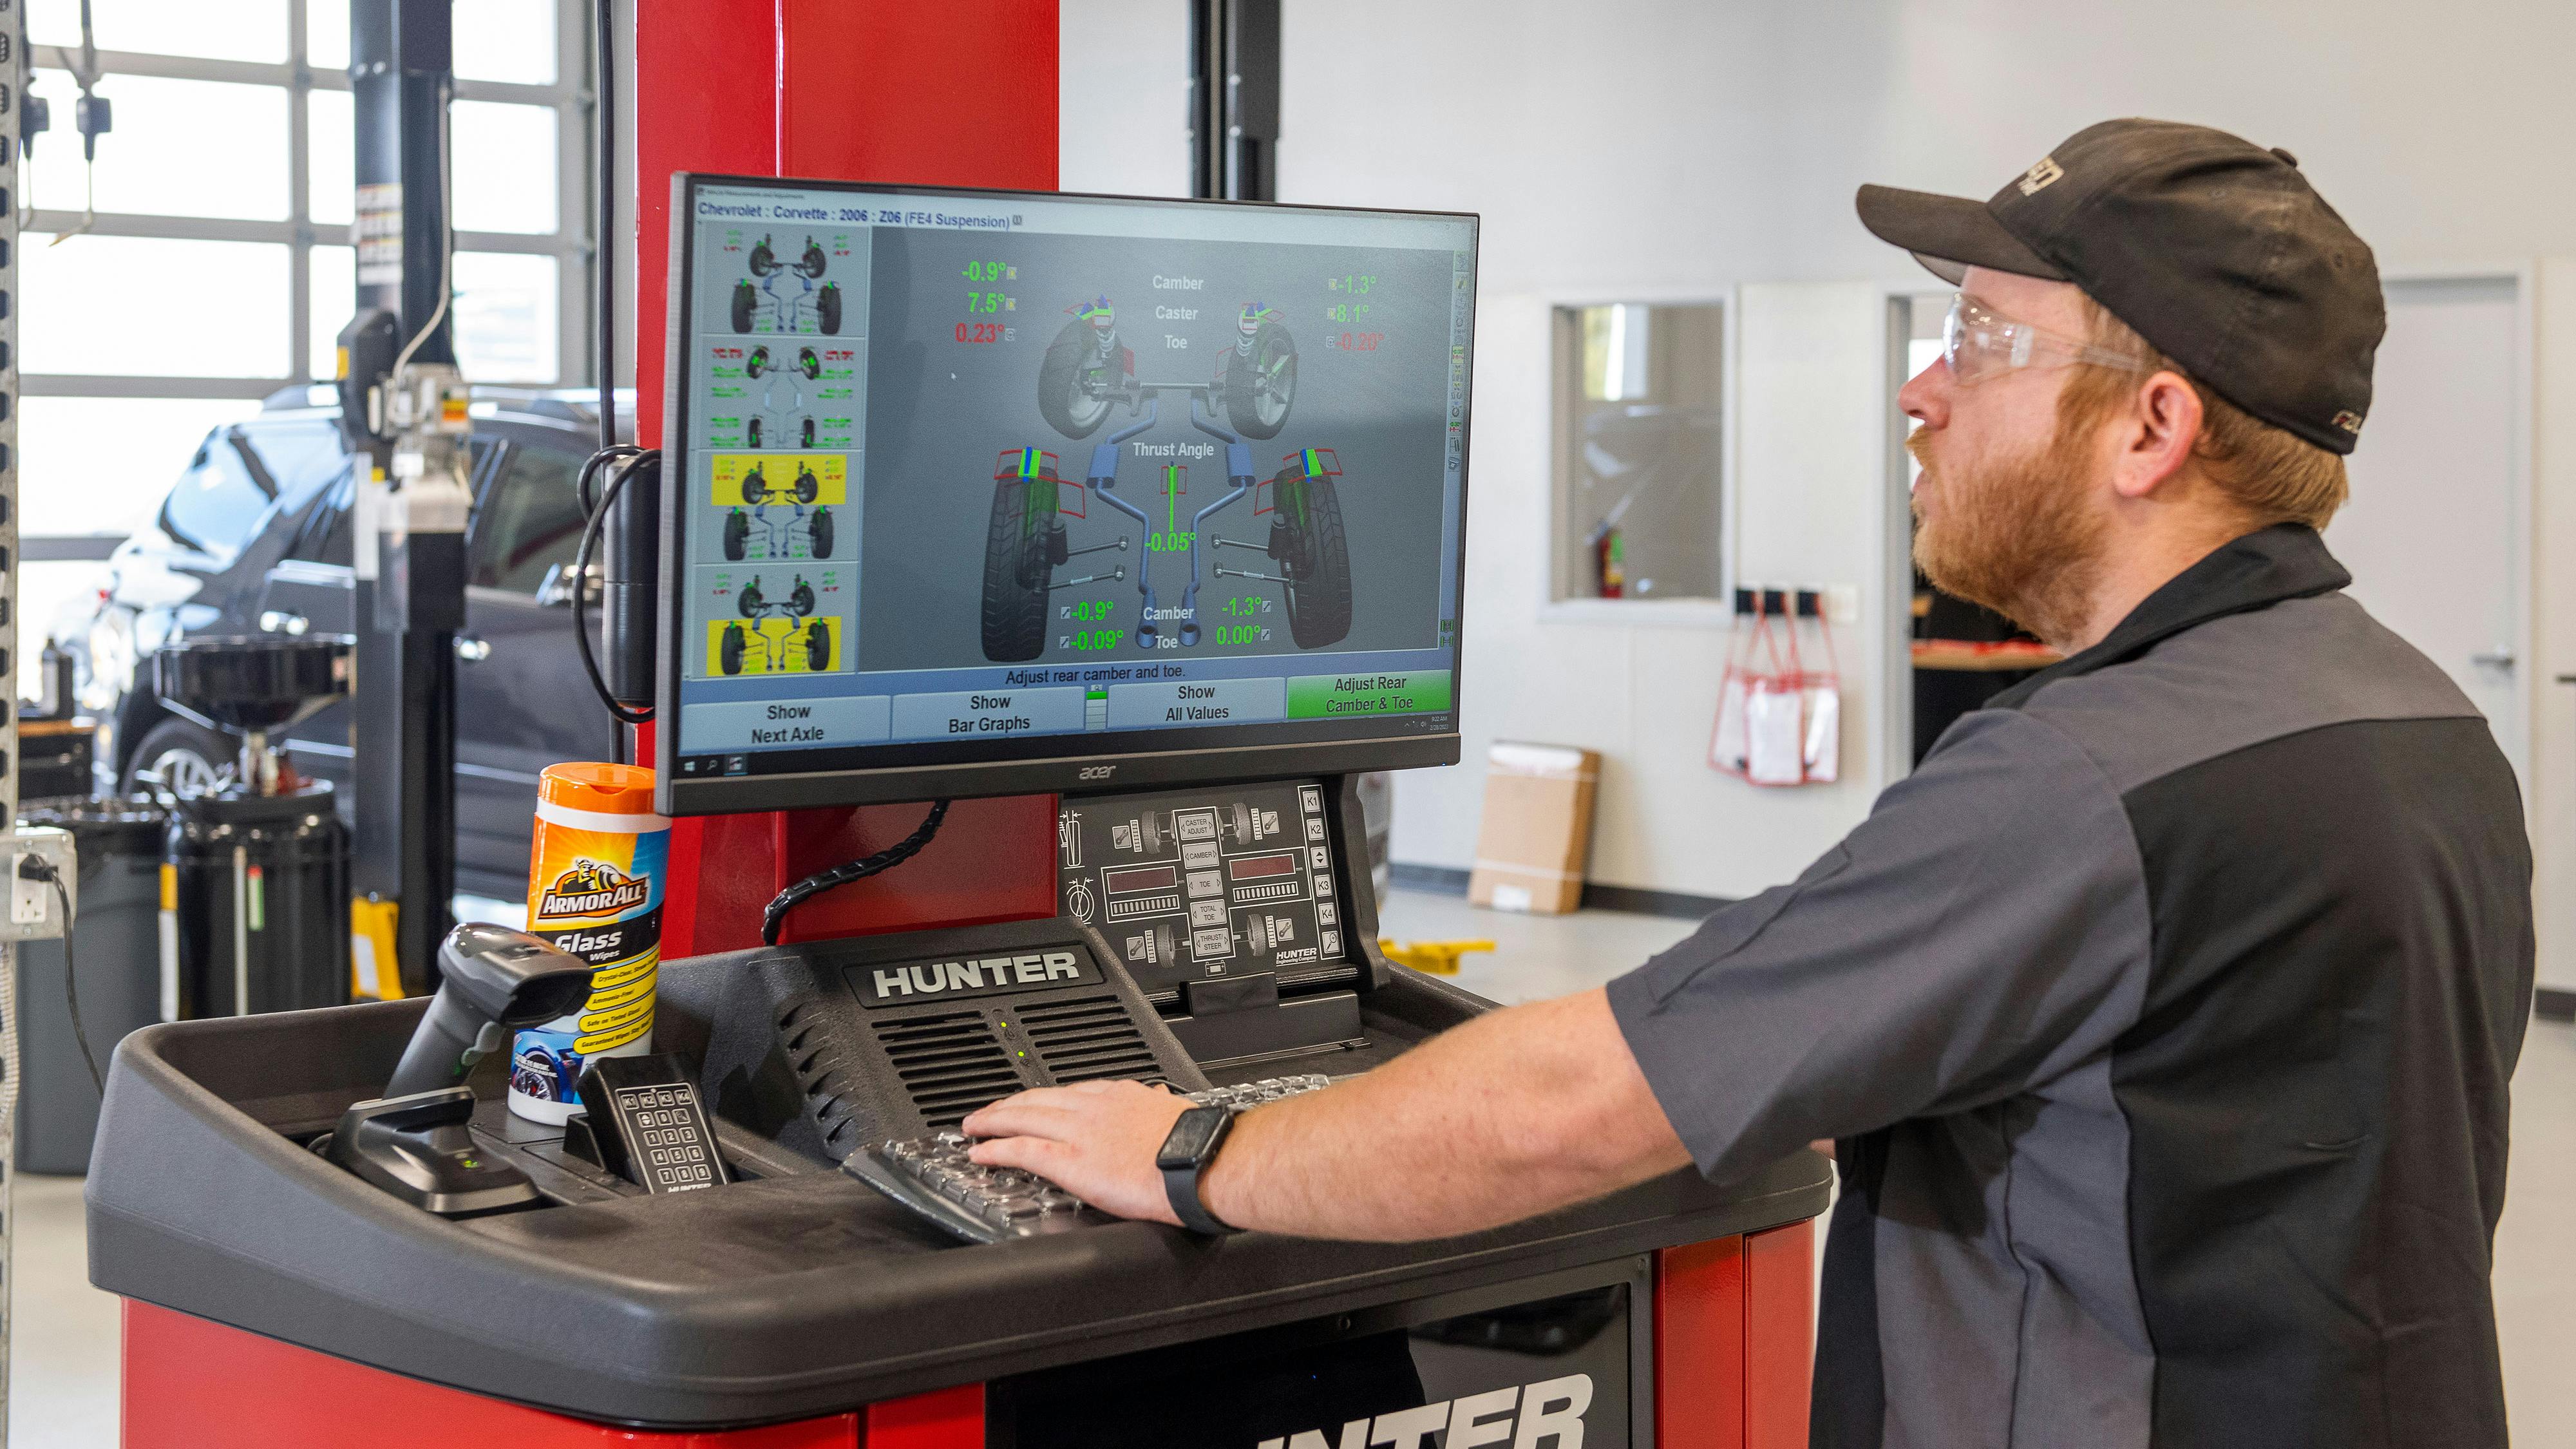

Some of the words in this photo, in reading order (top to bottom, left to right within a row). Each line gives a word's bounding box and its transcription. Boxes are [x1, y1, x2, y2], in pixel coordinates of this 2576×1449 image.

[697, 202, 762, 218] Chevrolet
[773, 205, 828, 220] Corvette
[839, 208, 867, 222] 2006
[879, 210, 901, 223] Z06
[905, 211, 932, 227] (FE4
[936, 213, 1010, 232] Suspension)
[1152, 274, 1204, 291] Camber
[1155, 305, 1198, 321] Caster
[1164, 334, 1188, 349] Toe
[1132, 442, 1175, 457] Thrust
[1177, 442, 1215, 459] Angle
[1143, 605, 1194, 621] Camber
[1155, 634, 1179, 649] Toe
[1005, 670, 1049, 687] Adjust
[1054, 671, 1079, 682] rear
[1083, 667, 1132, 681] camber
[1135, 665, 1159, 678] and
[1163, 665, 1186, 677] toe.
[1177, 685, 1215, 699] Show
[1334, 677, 1375, 694] Adjust
[1378, 676, 1407, 690] Rear
[970, 695, 1011, 710] Show
[1326, 697, 1376, 713] Camber
[1378, 696, 1388, 710] &
[1391, 695, 1414, 710] Toe
[766, 705, 811, 720] Show
[1166, 707, 1182, 722] All
[1186, 705, 1229, 720] Values
[949, 717, 974, 733] Bar
[978, 715, 1030, 733] Graphs
[751, 728, 788, 744] Next
[790, 726, 824, 742] Axle
[1079, 764, 1117, 781] acer
[1307, 796, 1318, 806] K1
[1187, 827, 1208, 835] ADJUST
[1310, 824, 1321, 835] K2
[1189, 851, 1213, 860] CAMBER
[1318, 880, 1330, 891] K3
[1321, 909, 1333, 919] K4
[554, 931, 623, 954] Glass
[1200, 933, 1224, 942] THRUST/
[589, 949, 620, 962] Wipes
[1276, 947, 1317, 960] HUNTER
[873, 952, 1079, 998] HUNTER
[650, 1134, 656, 1142] 1
[667, 1132, 675, 1141] 2
[685, 1130, 692, 1139] 3
[657, 1153, 664, 1162] 4
[674, 1150, 682, 1159] 5
[692, 1148, 699, 1158] 6
[663, 1171, 670, 1180] 7
[681, 1170, 688, 1179] 8
[699, 1168, 706, 1177] 9
